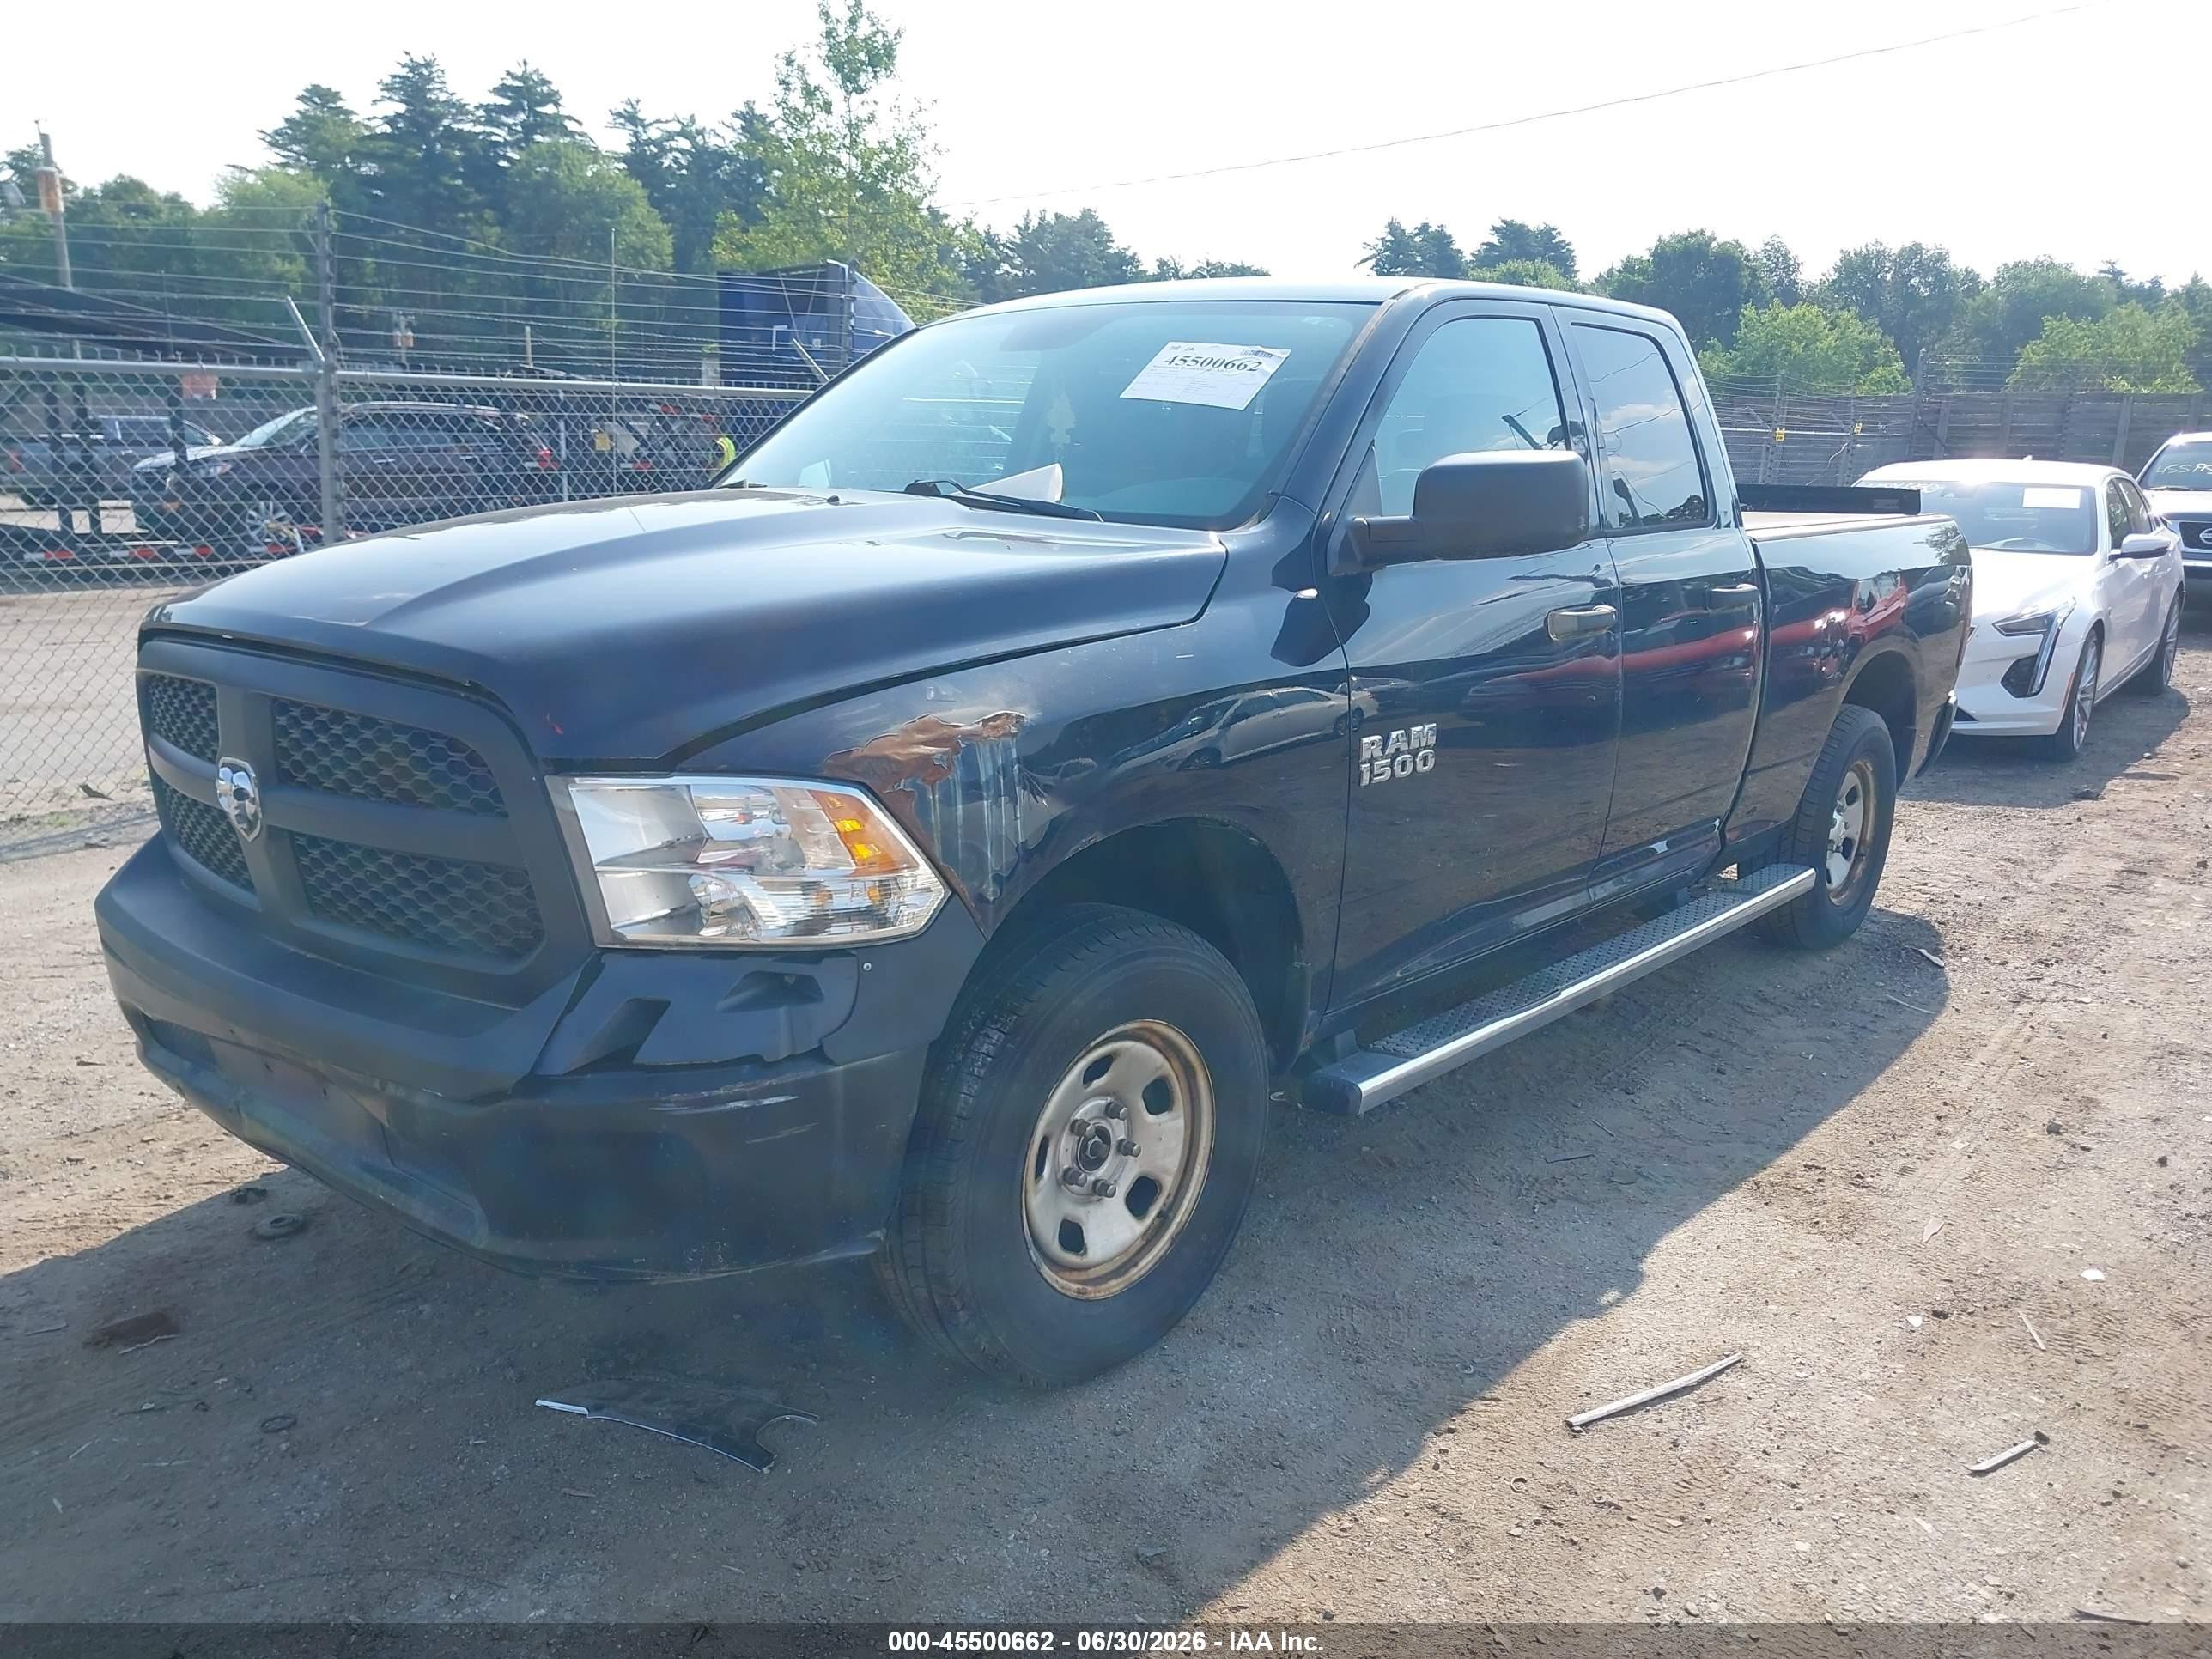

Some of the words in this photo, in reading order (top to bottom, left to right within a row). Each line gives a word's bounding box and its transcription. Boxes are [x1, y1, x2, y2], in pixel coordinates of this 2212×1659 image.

[1164, 354, 1262, 372] 45500662
[1360, 723, 1437, 761] RAM
[1360, 749, 1436, 787] 1500
